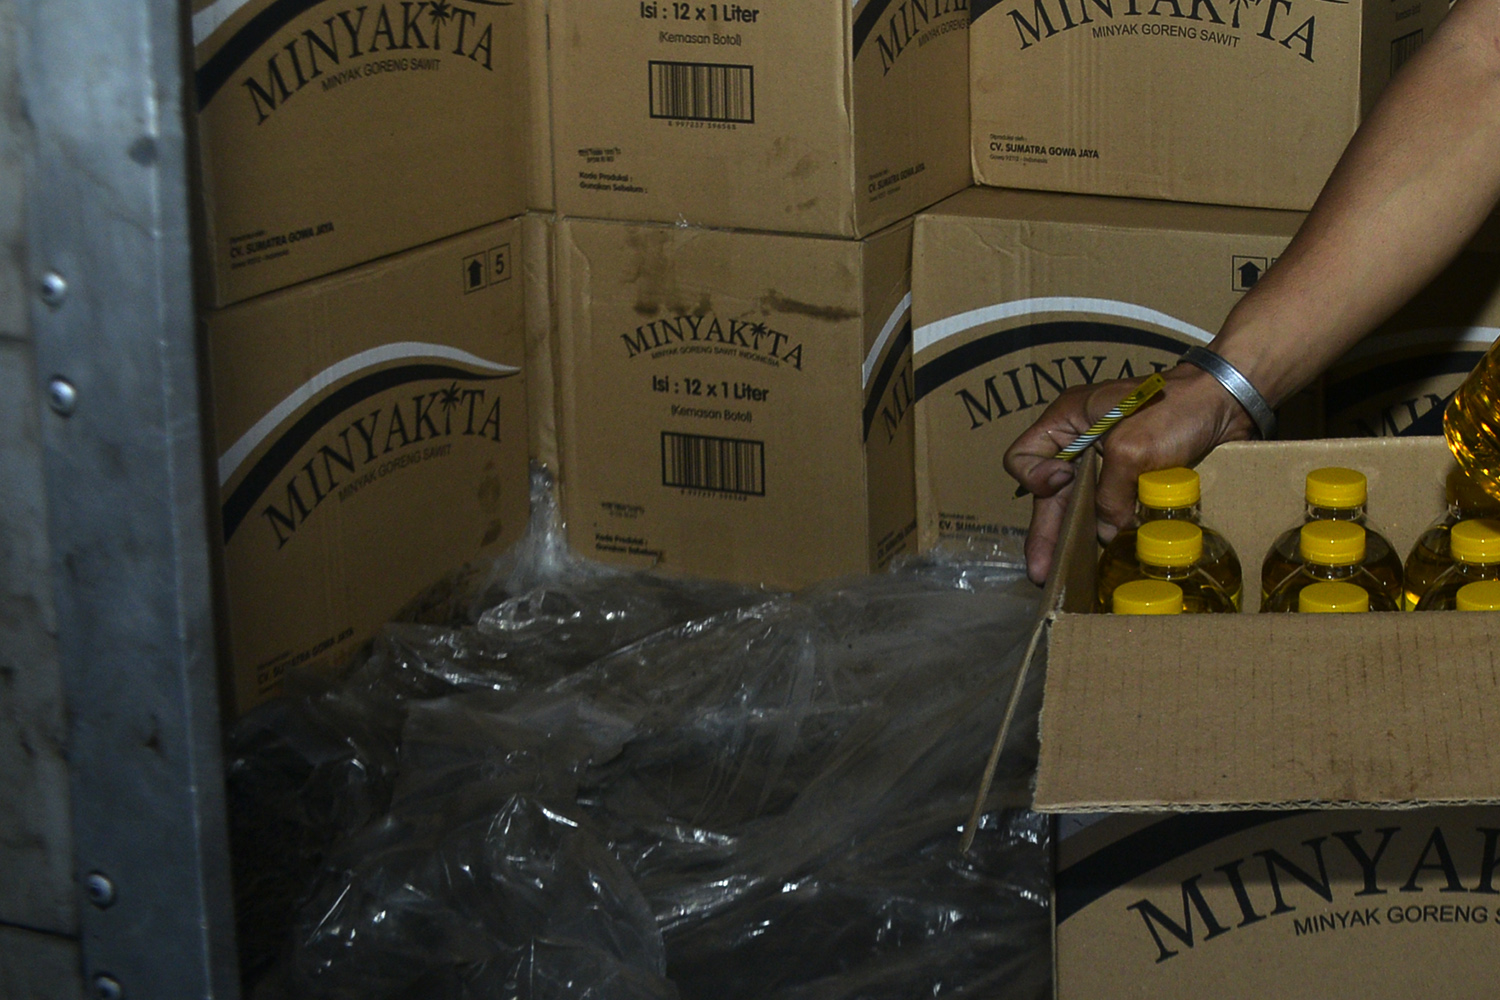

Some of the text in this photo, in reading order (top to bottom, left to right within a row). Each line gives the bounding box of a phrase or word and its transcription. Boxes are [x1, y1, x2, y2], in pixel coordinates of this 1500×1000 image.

[640, 1, 658, 19] Isi
[672, 2, 690, 21] 12
[695, 7, 706, 21] x
[710, 4, 718, 22] 1
[723, 4, 760, 24] Liter
[1091, 22, 1241, 49] MINYAK GORENG SAWIT
[320, 57, 442, 93] MINYAK GORENG SAWIT
[989, 141, 1100, 160] CV. SUMATRA GOWA JAYA
[496, 253, 505, 276] 5
[620, 315, 804, 372] MINYAKITA
[652, 375, 669, 393] Isi
[684, 377, 702, 396] 12
[706, 383, 718, 397] x
[721, 381, 729, 399] 1
[733, 382, 770, 403] Liter
[261, 381, 502, 550] MINYAKITA
[377, 451, 422, 479] GORENG
[1293, 906, 1380, 937] MINYAK
[1386, 904, 1489, 925] GORENG
